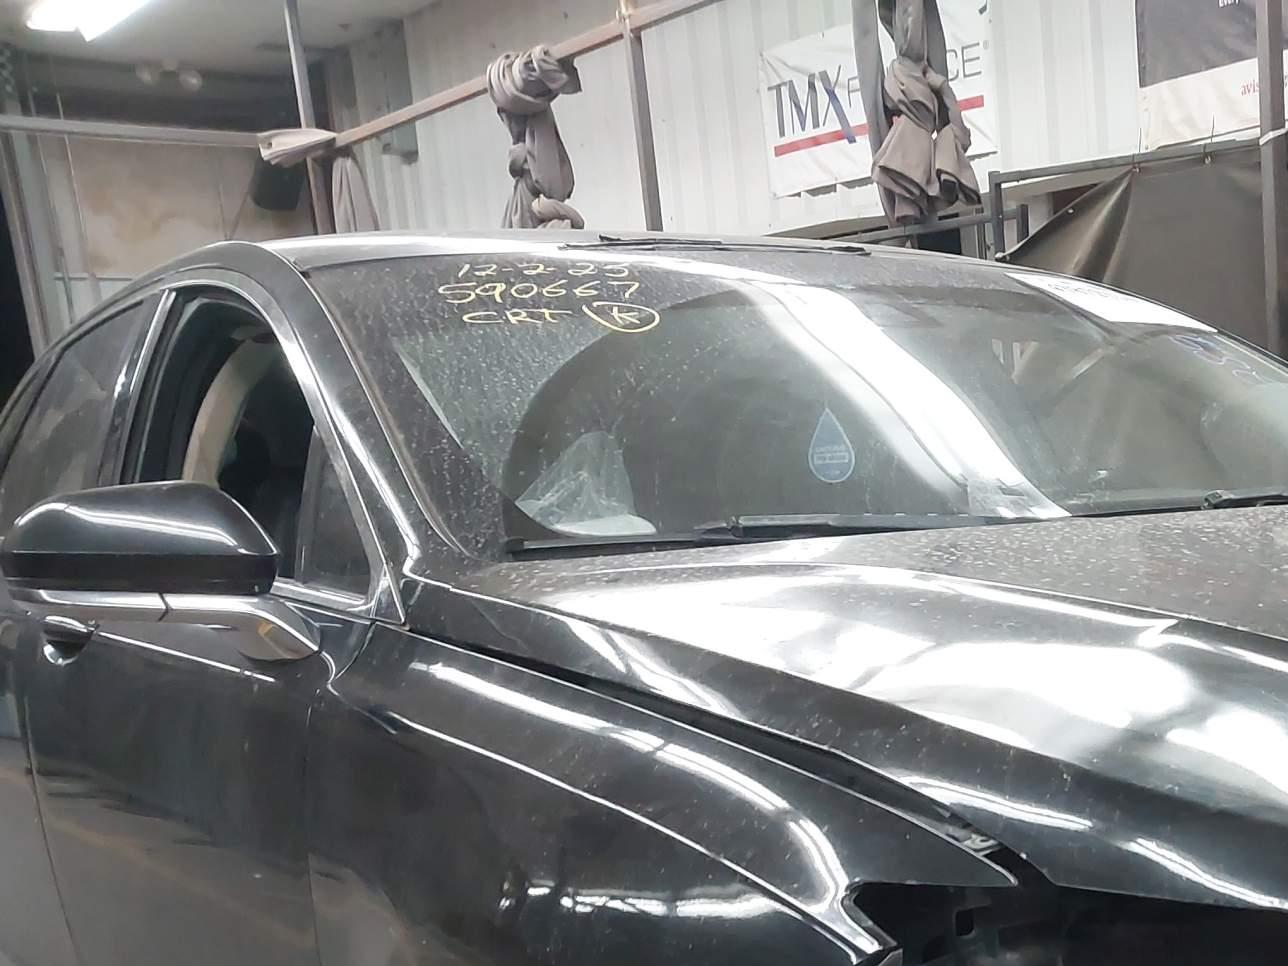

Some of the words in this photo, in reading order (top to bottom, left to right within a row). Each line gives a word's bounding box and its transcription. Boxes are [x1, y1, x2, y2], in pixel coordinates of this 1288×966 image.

[767, 64, 857, 144] TMX
[437, 279, 640, 304] 590667
[462, 308, 573, 325] CRT
